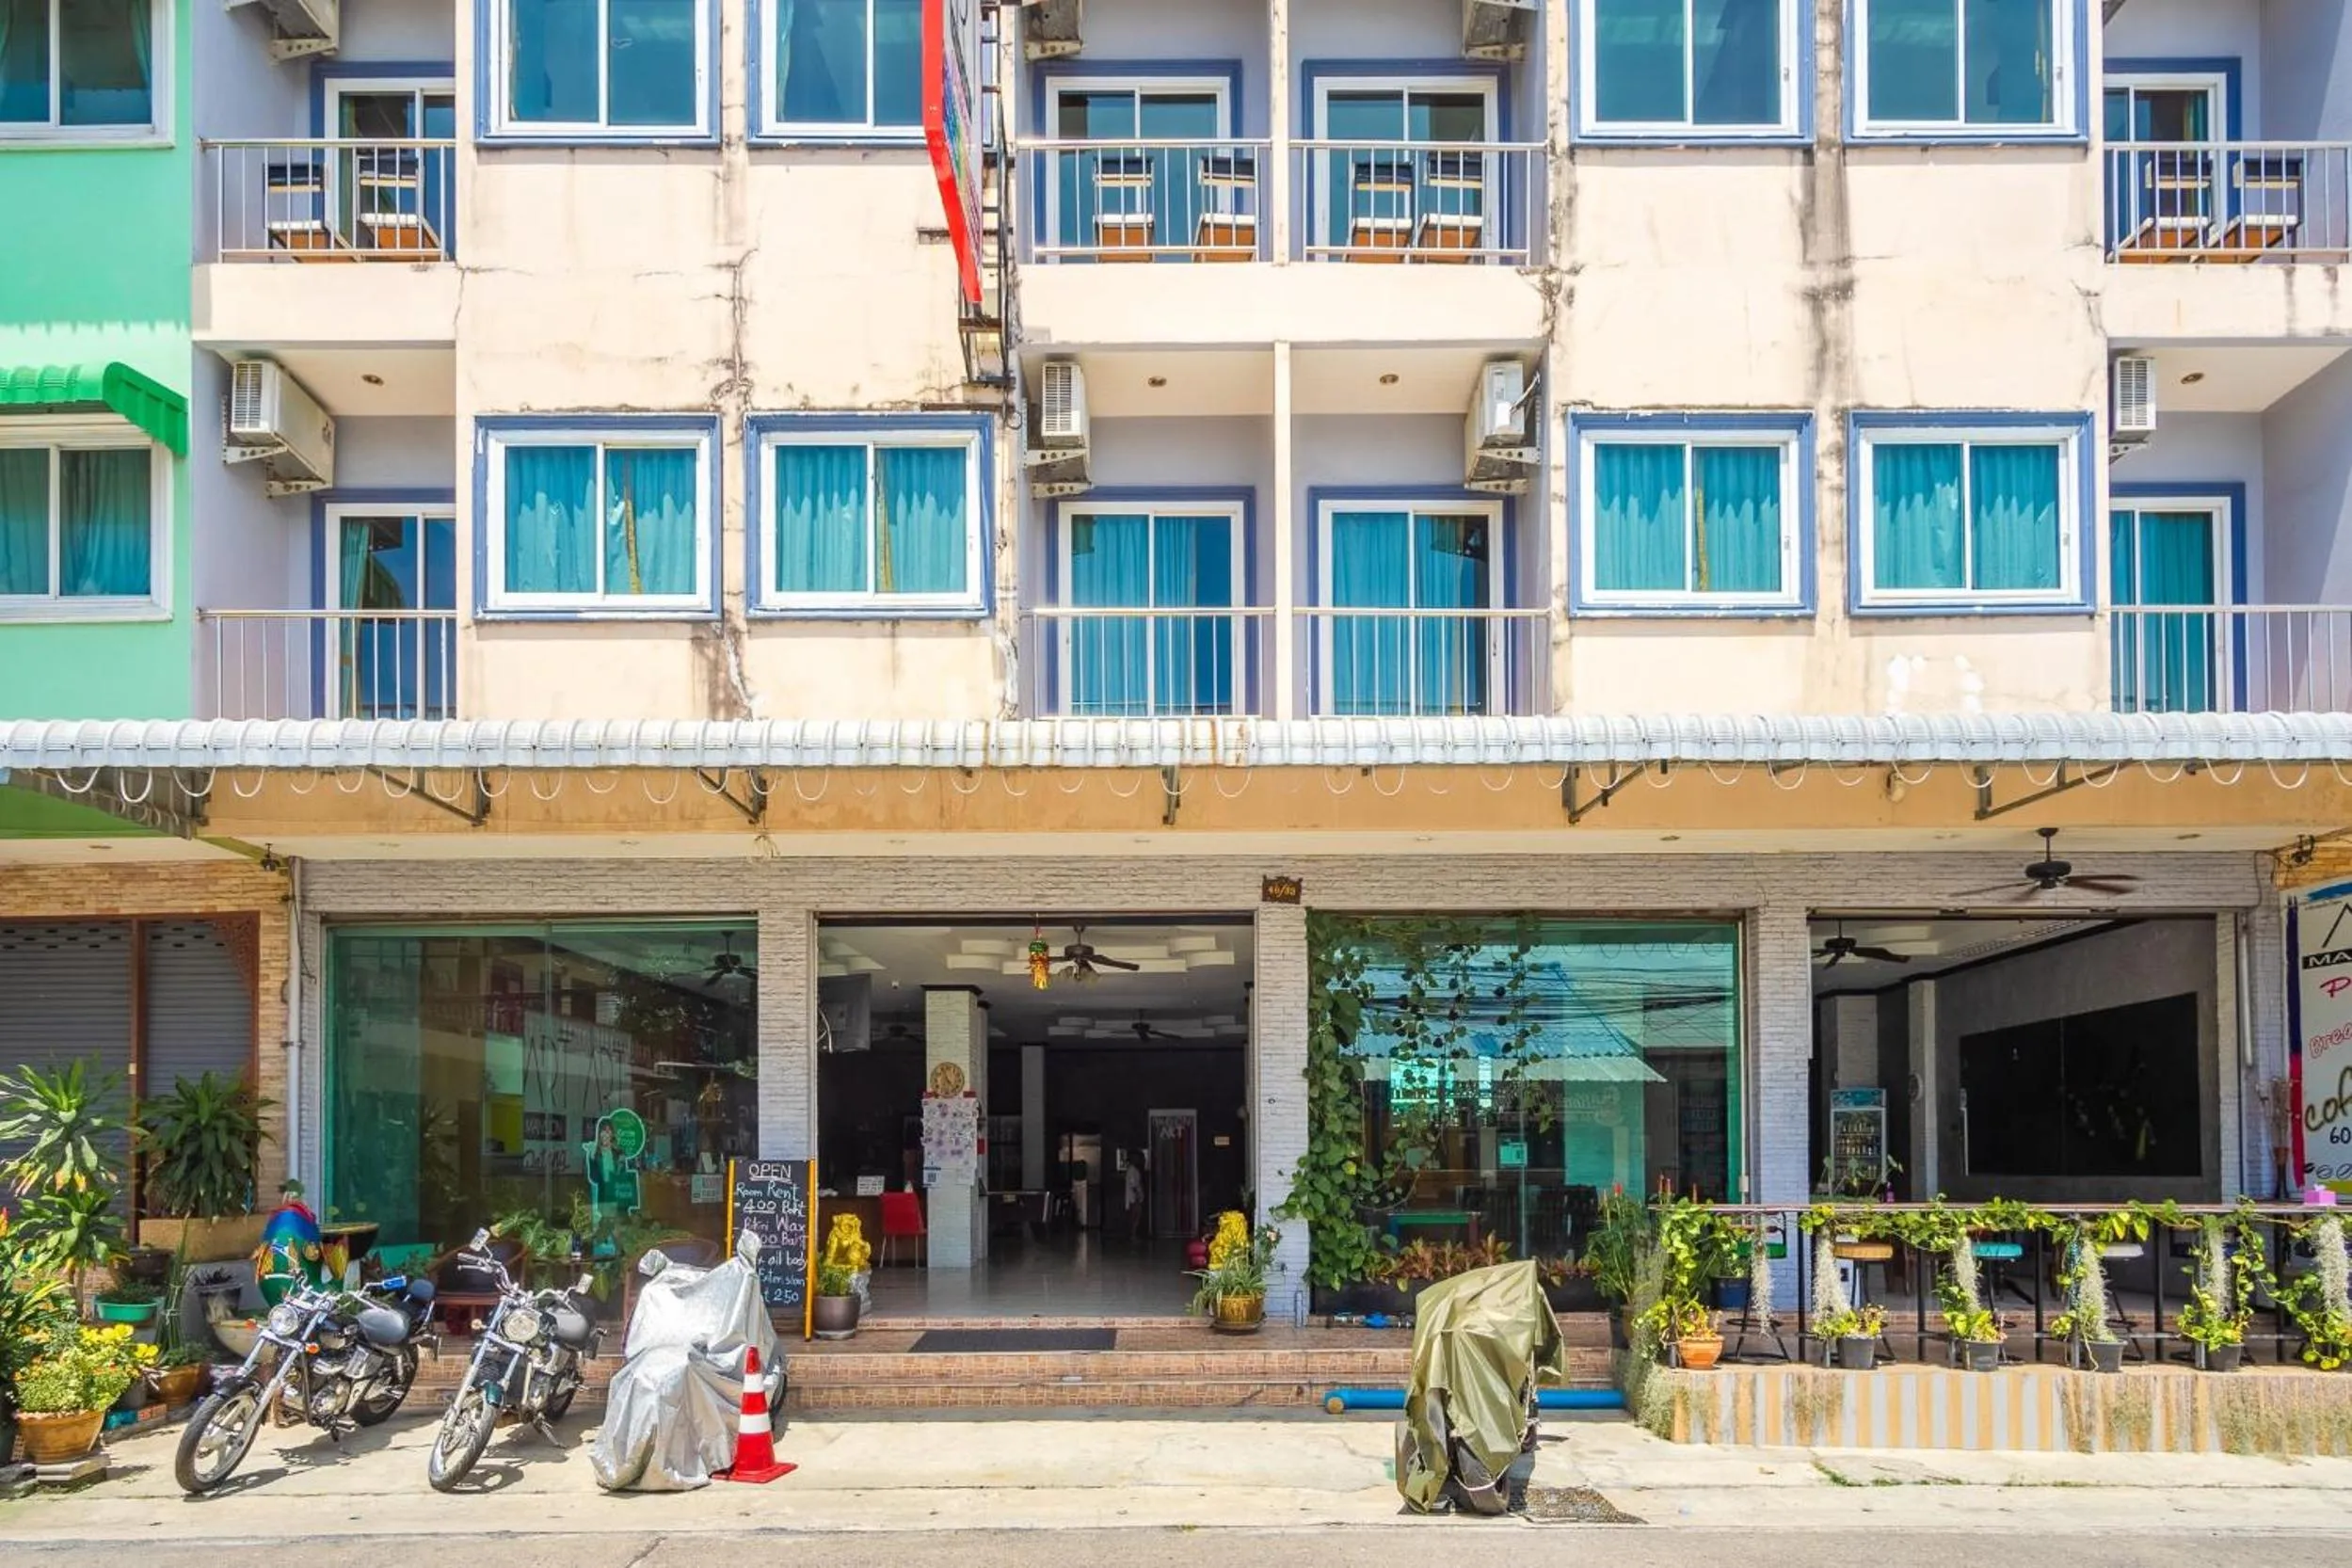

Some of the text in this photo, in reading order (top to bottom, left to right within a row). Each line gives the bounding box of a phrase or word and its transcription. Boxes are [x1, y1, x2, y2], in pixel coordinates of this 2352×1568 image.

[2329, 1126, 2351, 1144] 60
[748, 1162, 792, 1178] OPEN
[736, 1181, 763, 1198] Room
[767, 1178, 801, 1202] Rent
[743, 1198, 777, 1213] 400
[774, 1288, 800, 1304] 250
